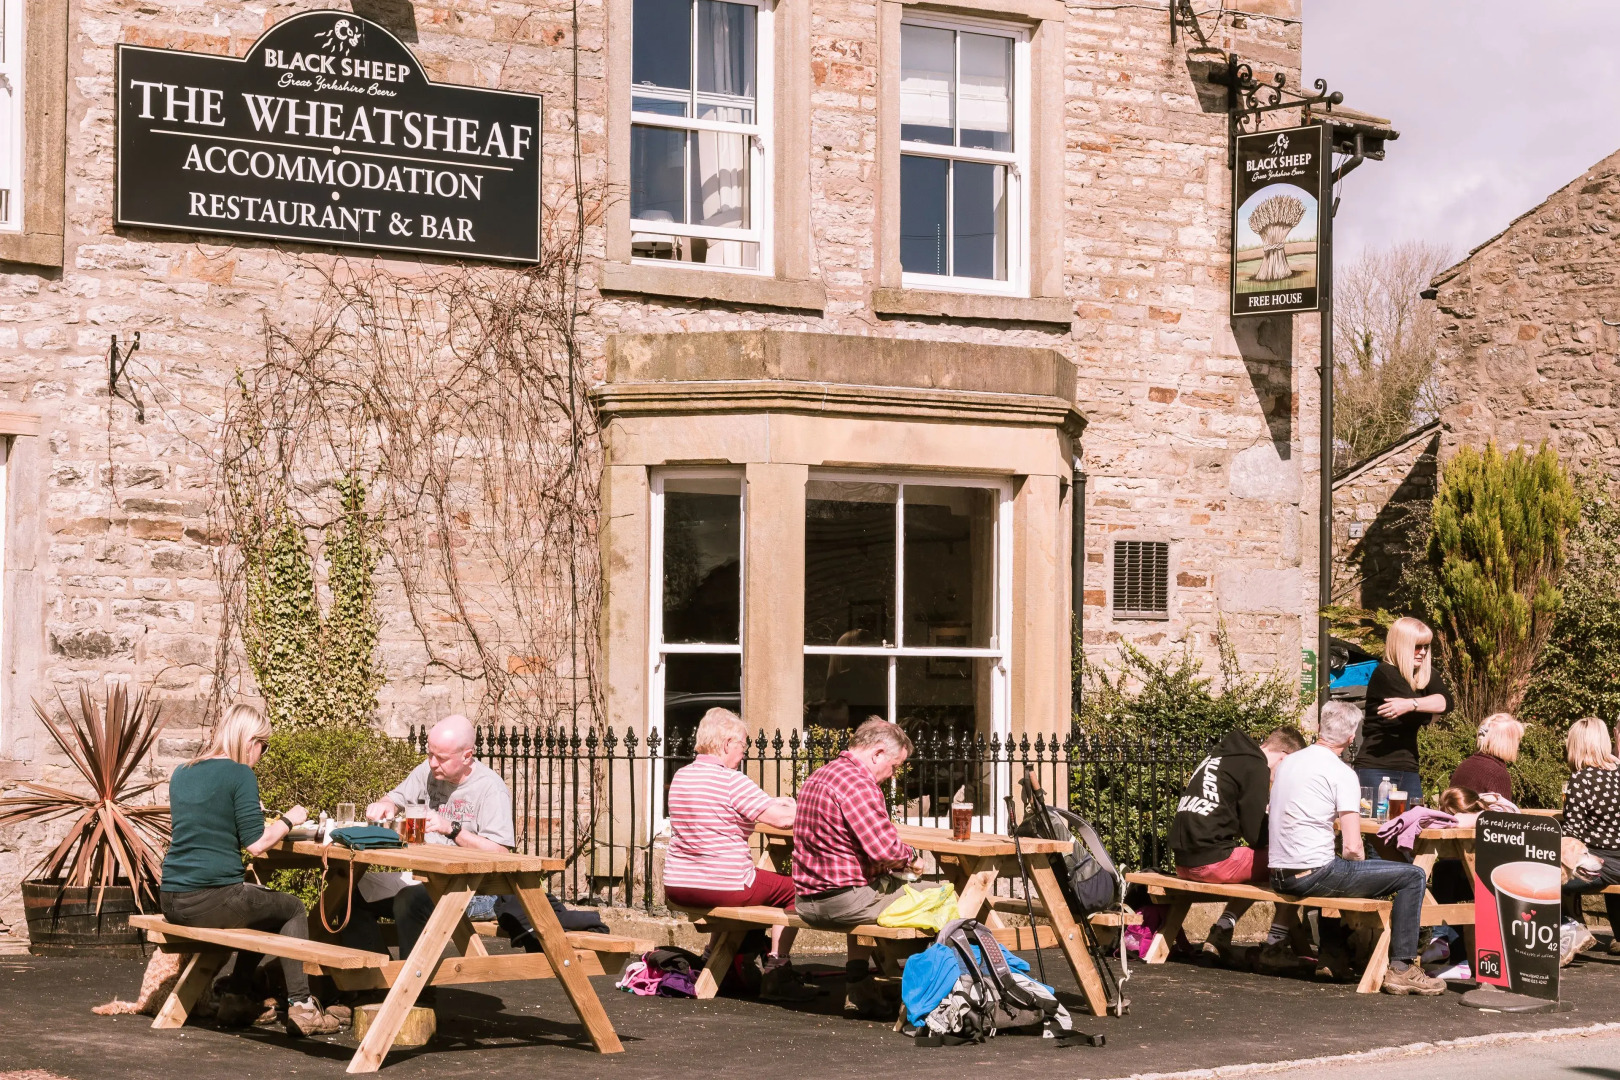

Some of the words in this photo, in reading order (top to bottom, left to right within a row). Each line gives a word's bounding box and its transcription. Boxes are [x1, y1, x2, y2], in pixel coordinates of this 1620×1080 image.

[265, 48, 336, 75] BLACK
[341, 57, 411, 83] SHEEP
[278, 72, 312, 88] Great
[314, 75, 365, 94] Yorkshire
[367, 82, 397, 97] Beers
[130, 79, 226, 127] THE
[241, 92, 532, 161] WHEATSHEAF
[182, 143, 484, 201] ACCOMMODATION
[1246, 157, 1278, 172] BLACK
[1280, 153, 1312, 168] SHEEP
[188, 191, 381, 233] RESTAURANT
[388, 212, 413, 237] &
[420, 214, 476, 243] BAR
[1248, 295, 1270, 308] FREE
[1271, 292, 1303, 306] HOUSE
[1478, 816, 1489, 826] The
[1490, 819, 1504, 828] real
[1504, 821, 1522, 831] spirit
[1523, 821, 1531, 830] of
[1483, 828, 1525, 846] Served
[1525, 844, 1557, 861] Here
[1547, 942, 1558, 951] 42
